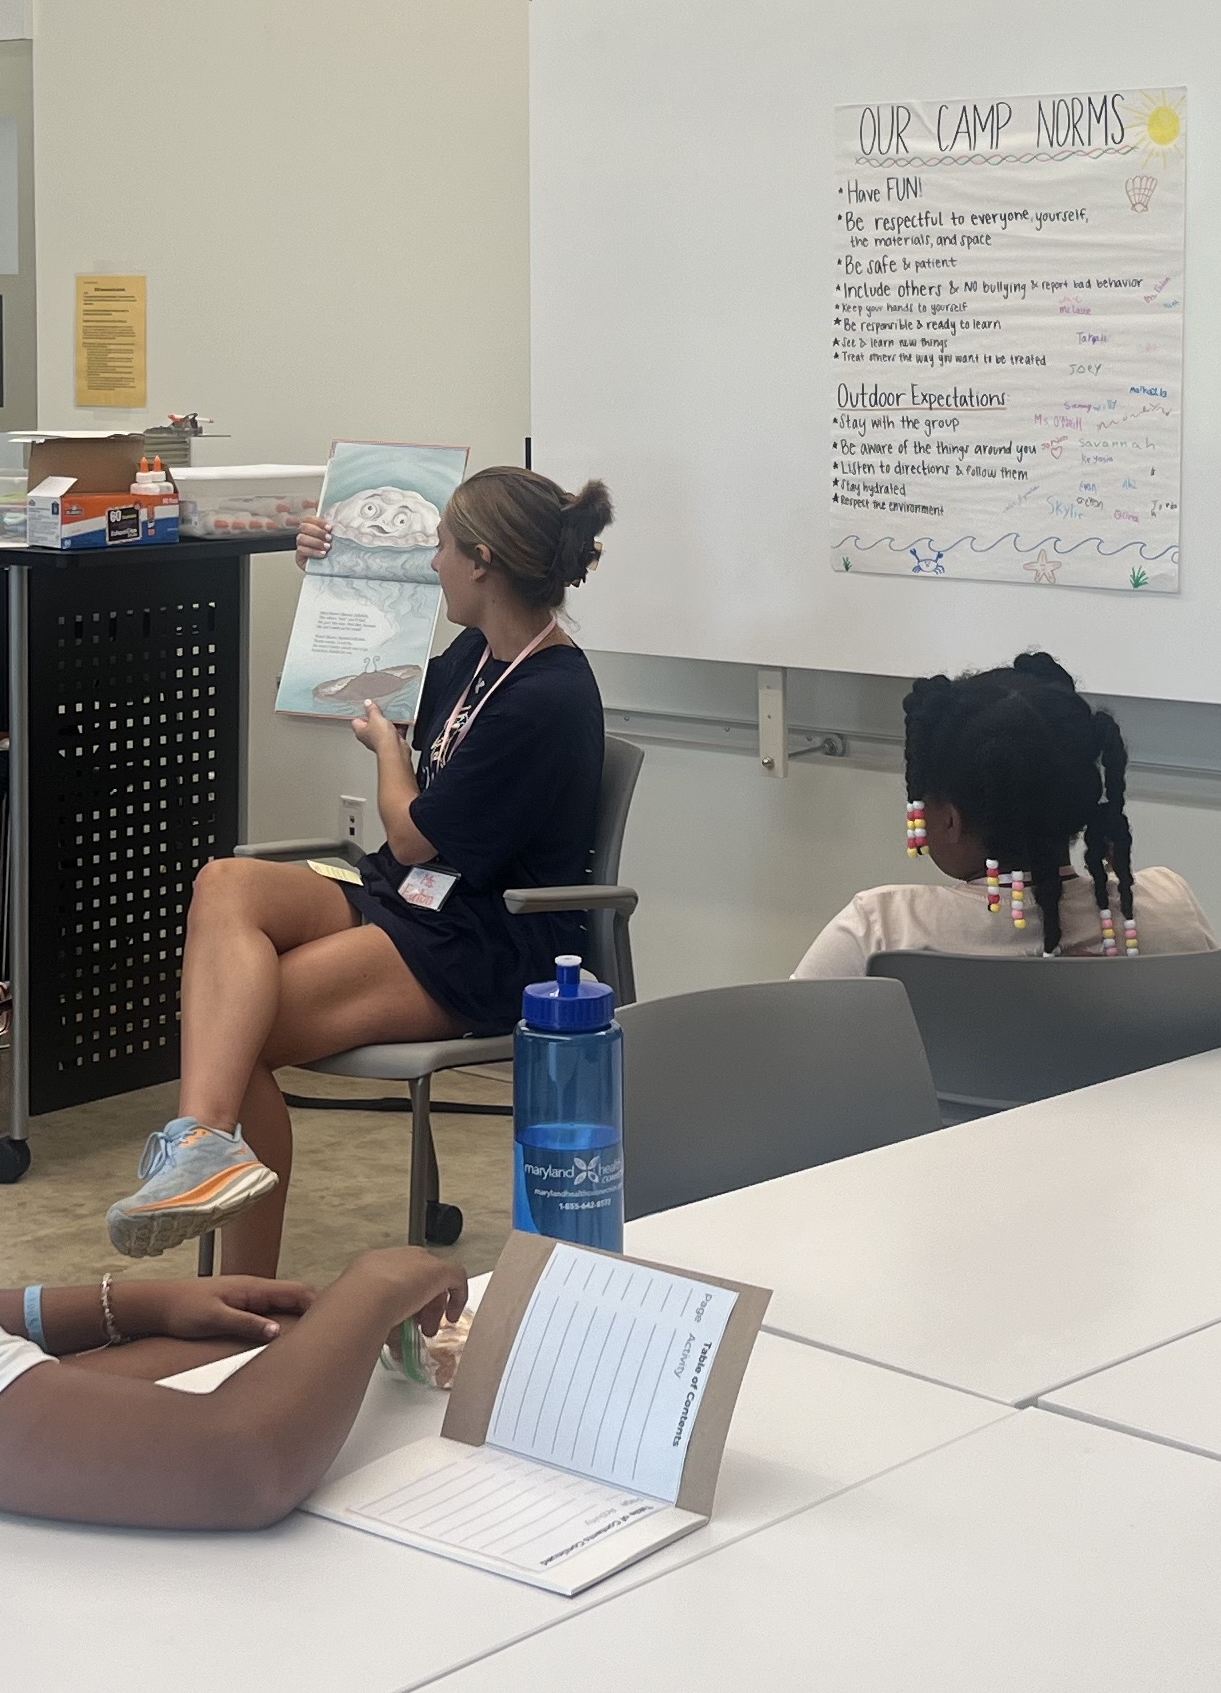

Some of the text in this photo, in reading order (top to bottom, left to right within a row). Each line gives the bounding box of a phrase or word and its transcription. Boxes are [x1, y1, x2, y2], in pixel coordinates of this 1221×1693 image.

[859, 93, 1125, 155] OUR CAMP NORMS
[847, 176, 922, 204] Have FUN!
[845, 211, 864, 231] Be
[874, 210, 943, 234] respectful
[951, 211, 965, 226] to
[1035, 208, 1088, 231] yourself,
[850, 234, 992, 250] the materials, and space
[845, 254, 958, 275] Be safe & patient
[843, 277, 1143, 300] Include others & NO bullying & report bad behavior
[842, 302, 968, 318] Keep your hands to yourself
[843, 318, 1002, 336] Be responsible & ready to learn
[841, 337, 857, 348] See
[870, 338, 895, 348] learn
[899, 339, 917, 348] new
[921, 338, 948, 353] things
[842, 351, 865, 362] Treat
[869, 352, 897, 363] others
[899, 352, 912, 363] the
[915, 353, 934, 367] way
[938, 354, 953, 367] you
[955, 353, 979, 364] want
[995, 354, 1006, 364] be
[1010, 354, 1046, 366] treated
[837, 382, 906, 408] Outdoor
[839, 413, 960, 437] Stay with the group
[840, 439, 1037, 463] Be aware of the things around you
[841, 460, 1029, 480] Listen to directions & follow them
[840, 479, 906, 497] Stay hydrated
[840, 495, 944, 516] Respect the environment
[524, 1163, 575, 1181] maryland
[694, 1293, 713, 1323] Page
[673, 1333, 696, 1379] Activity
[672, 1341, 713, 1448] Table of Contents
